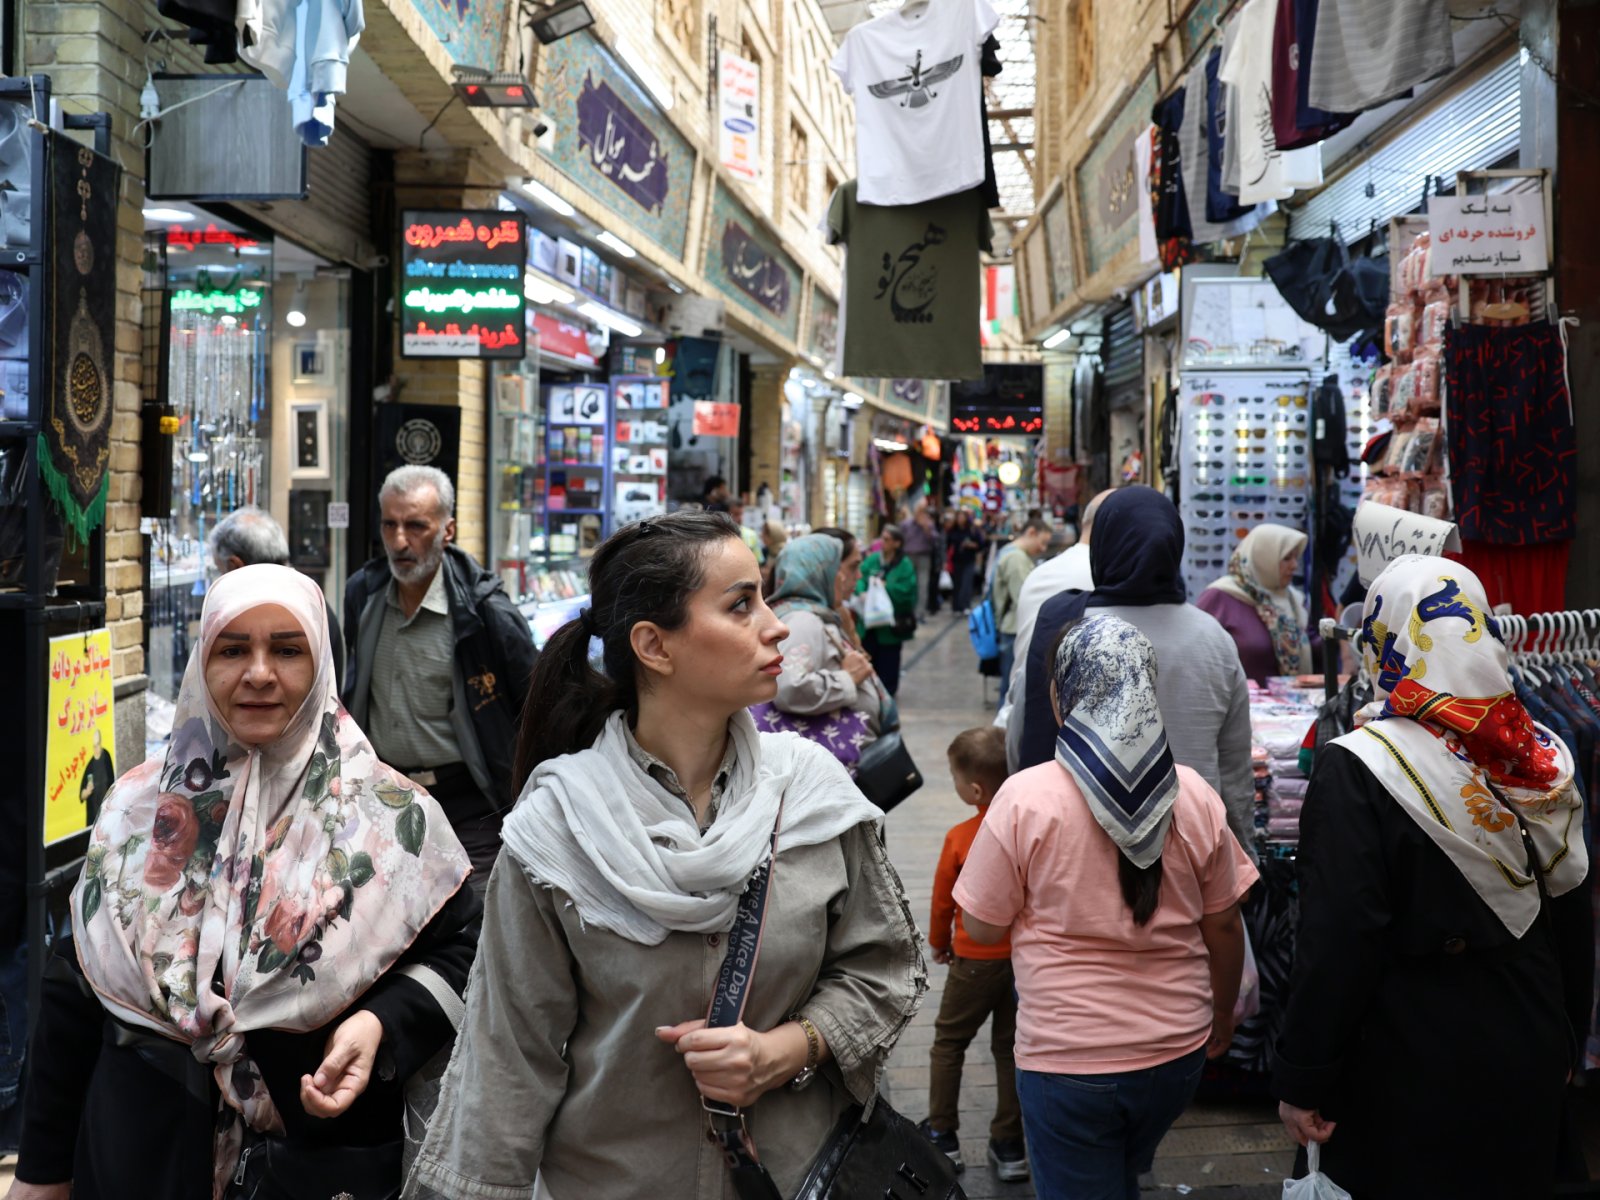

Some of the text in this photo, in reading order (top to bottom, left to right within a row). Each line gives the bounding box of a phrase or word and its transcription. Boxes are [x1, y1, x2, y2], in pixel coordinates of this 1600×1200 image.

[1461, 203, 1511, 217] به یک
[1438, 224, 1536, 243] فروشنده حرفه ای
[1452, 249, 1522, 267] نیازمندیم
[52, 652, 81, 689] مردانه
[58, 690, 107, 734] سایز بزرگ
[50, 770, 66, 801] است
[742, 911, 759, 925] A
[735, 928, 756, 968] Nice
[724, 973, 746, 1008] Day
